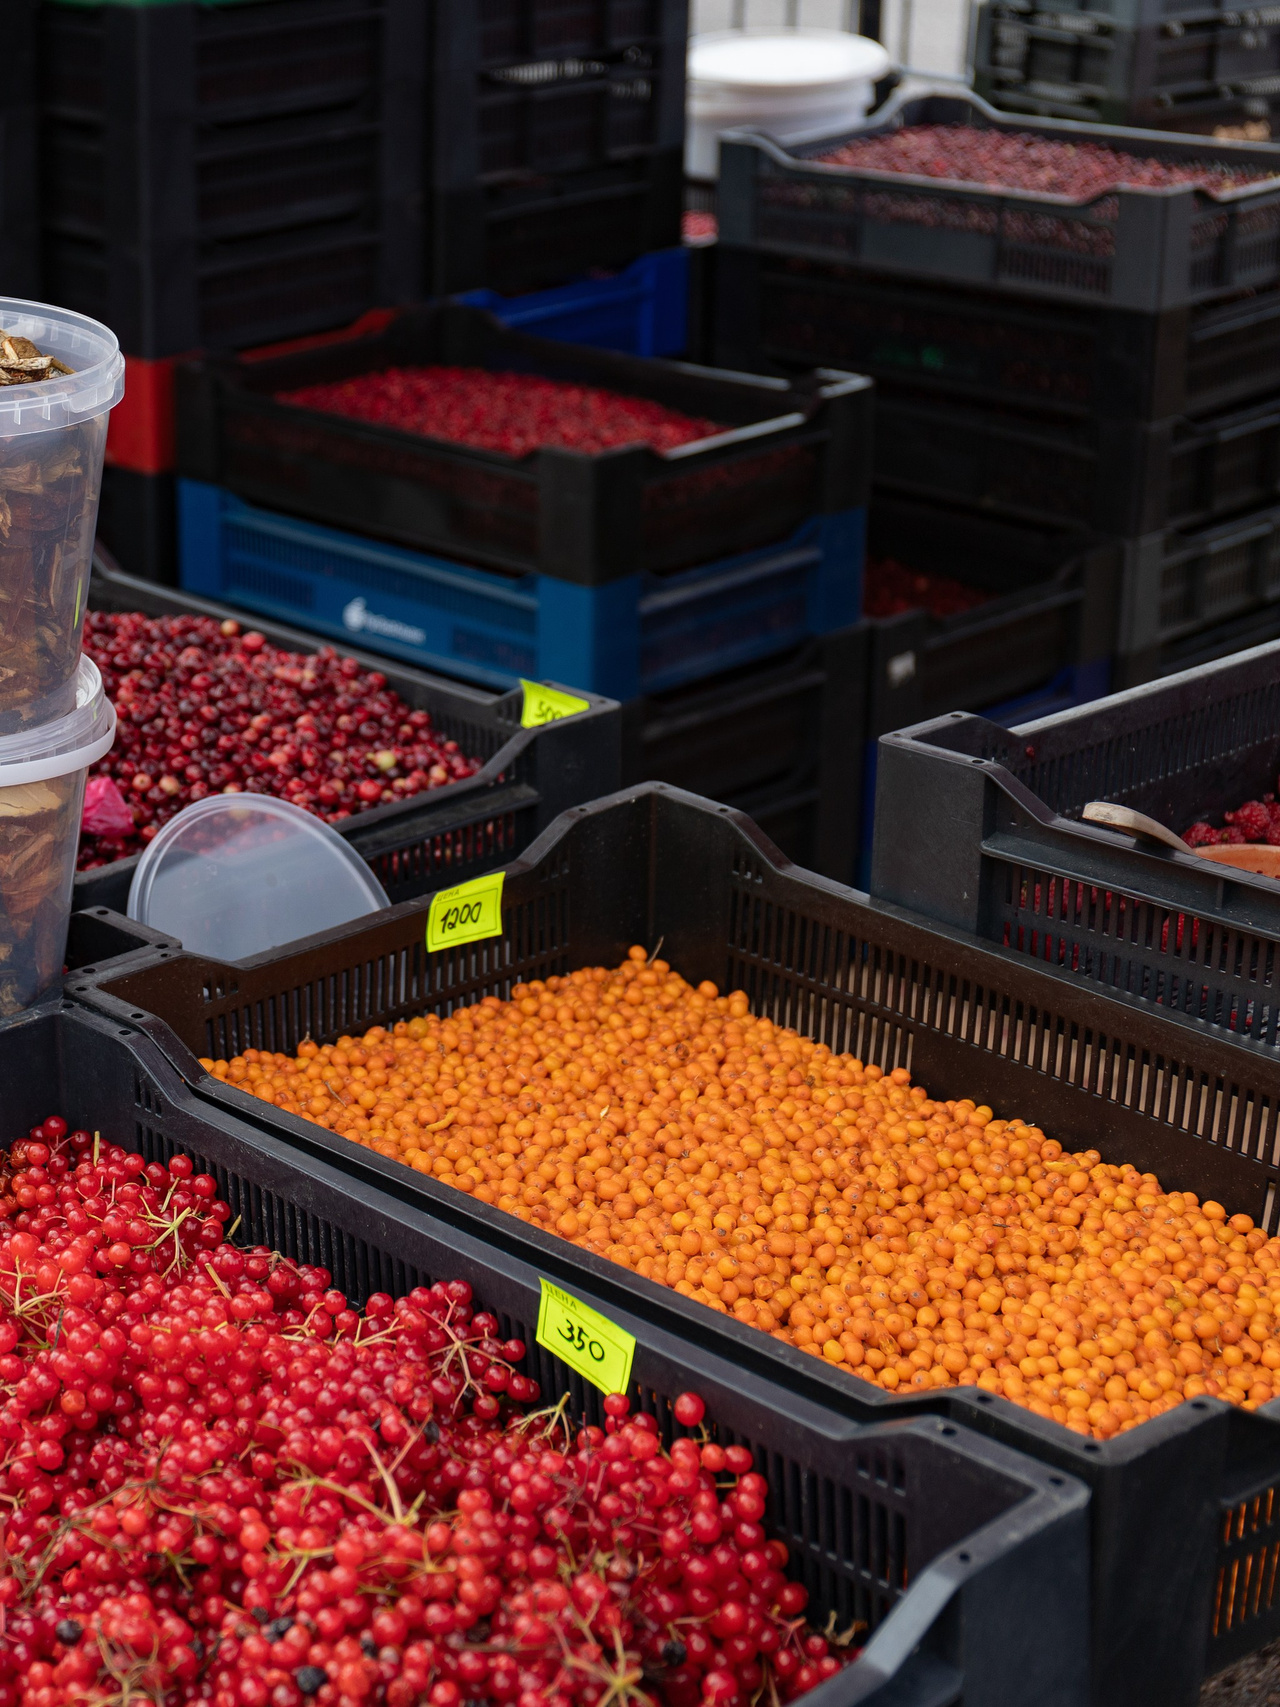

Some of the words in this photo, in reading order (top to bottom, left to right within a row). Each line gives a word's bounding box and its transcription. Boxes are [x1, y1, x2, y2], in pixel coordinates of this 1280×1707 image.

[437, 889, 460, 902] ЦЕНА
[440, 901, 482, 934] 1200
[545, 1283, 577, 1312] ЦЕНА
[556, 1318, 605, 1362] 350
